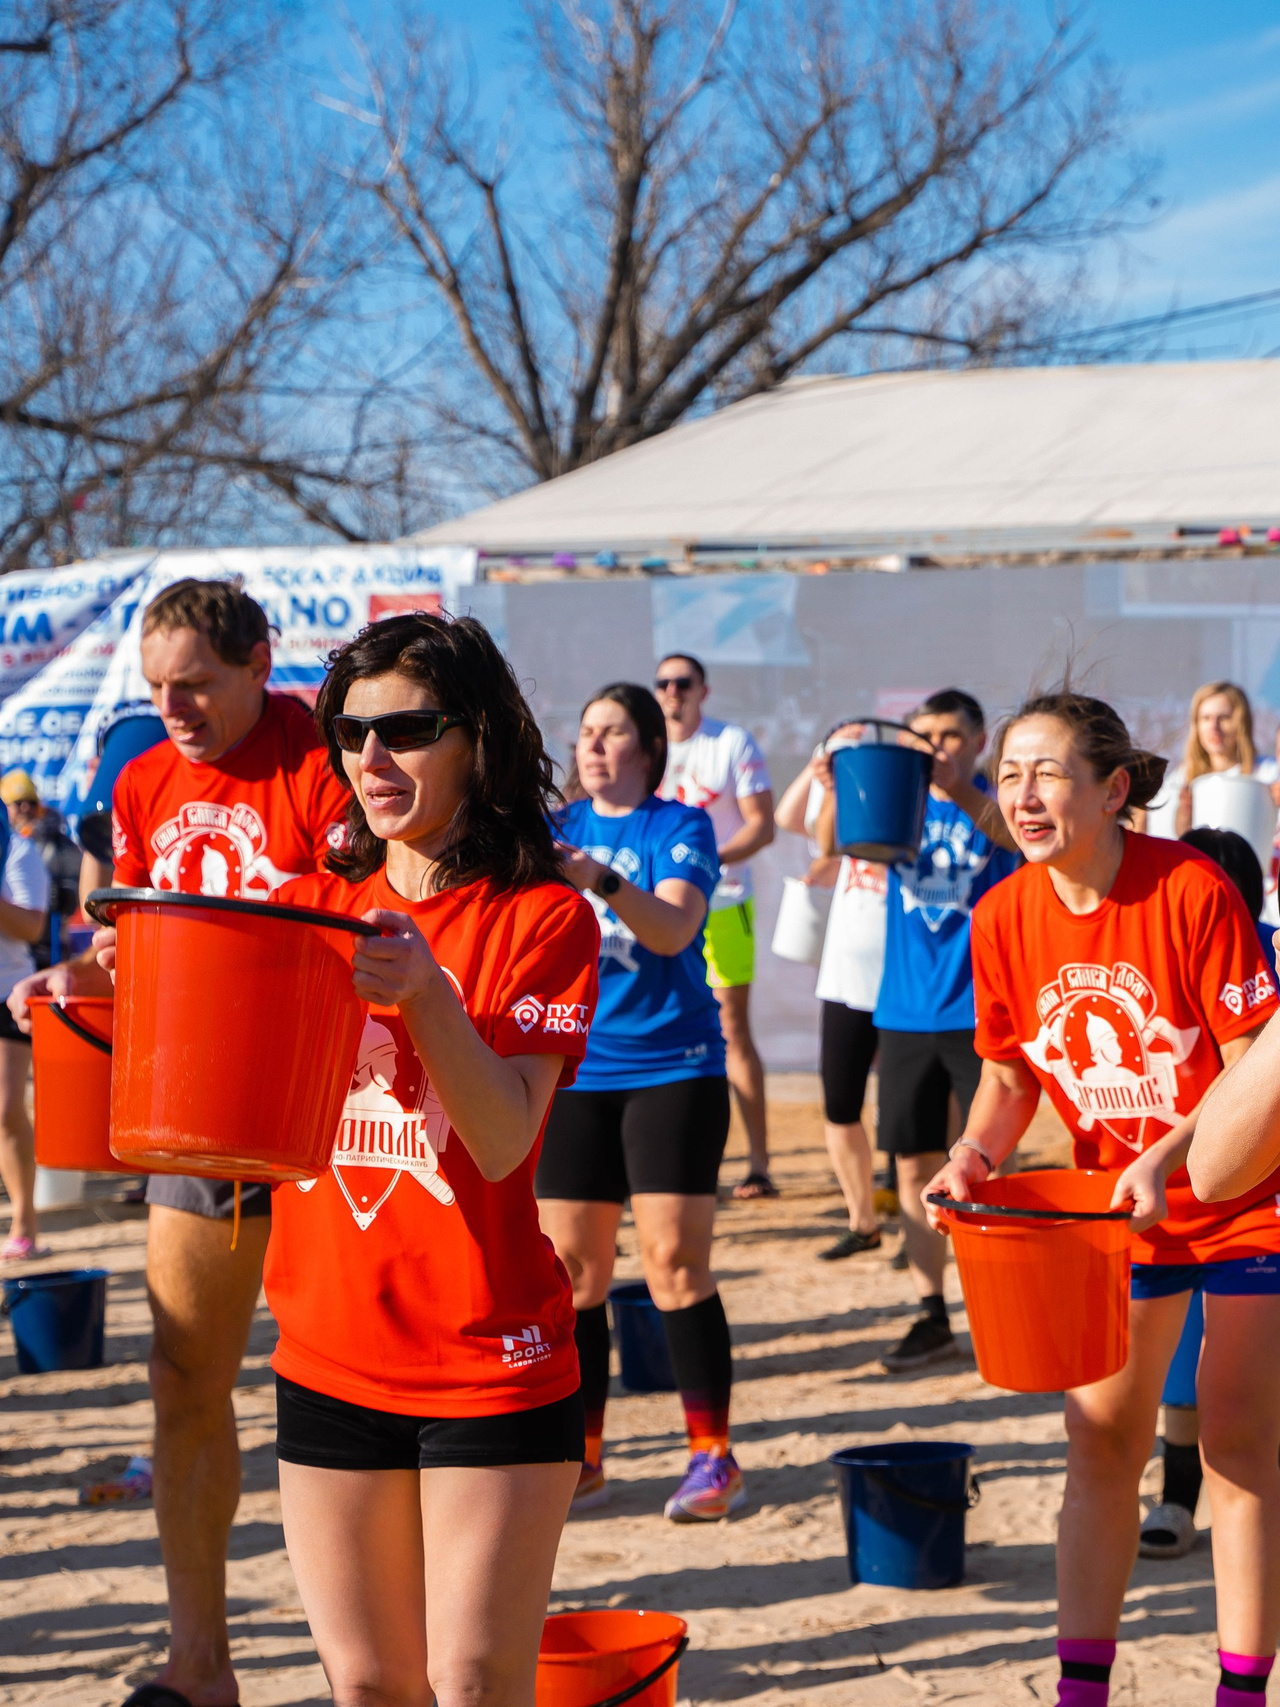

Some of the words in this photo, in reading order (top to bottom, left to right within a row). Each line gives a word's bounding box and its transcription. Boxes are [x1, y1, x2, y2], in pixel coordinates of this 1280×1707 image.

[547, 1004, 588, 1019] ПУТ
[337, 1117, 428, 1160] ОПОЛК
[335, 1153, 410, 1166] НО-ПАТРИОТИЧЕСКИЙ
[410, 1160, 428, 1168] КЛУБ
[502, 1343, 551, 1363] SPORT
[508, 1353, 552, 1368] LABORATORY
